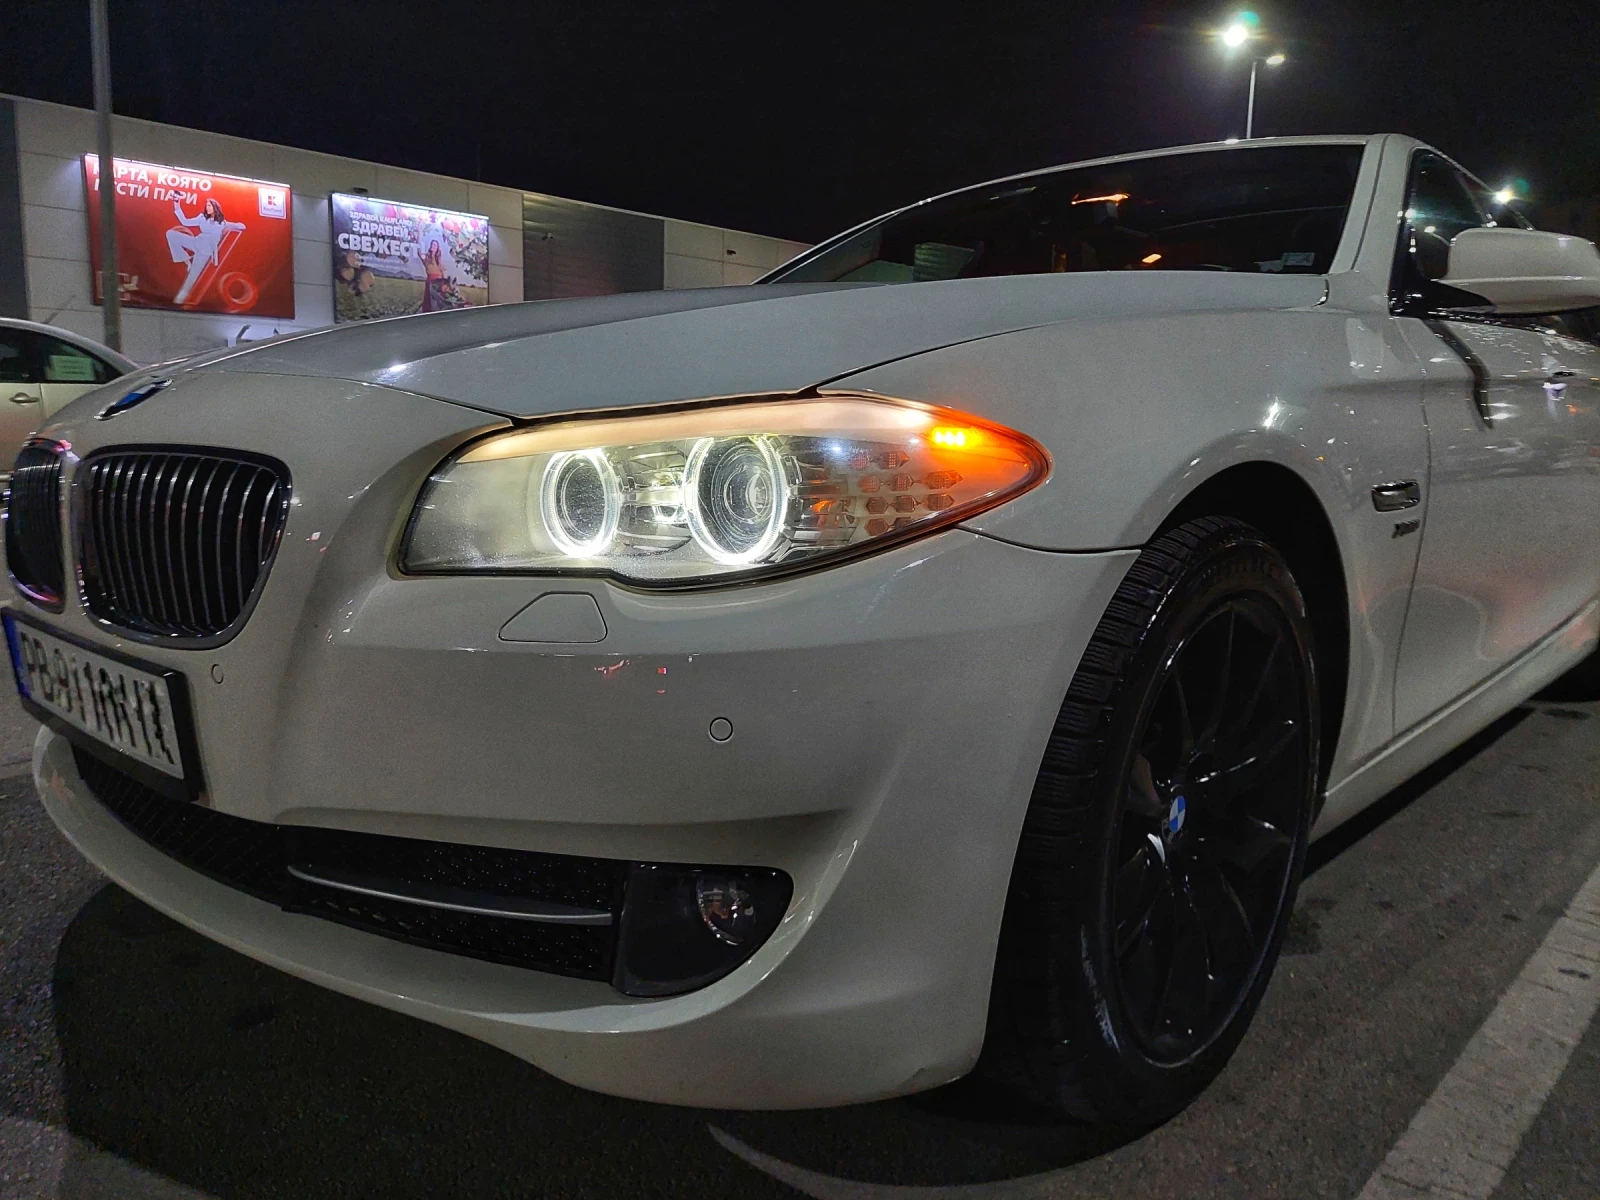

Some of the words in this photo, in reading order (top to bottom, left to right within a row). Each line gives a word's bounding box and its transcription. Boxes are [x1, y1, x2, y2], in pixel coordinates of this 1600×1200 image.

[93, 163, 153, 185] РТА,
[157, 172, 212, 192] КОЯТО
[94, 178, 150, 199] СТИ
[153, 187, 198, 205] ПАРИ
